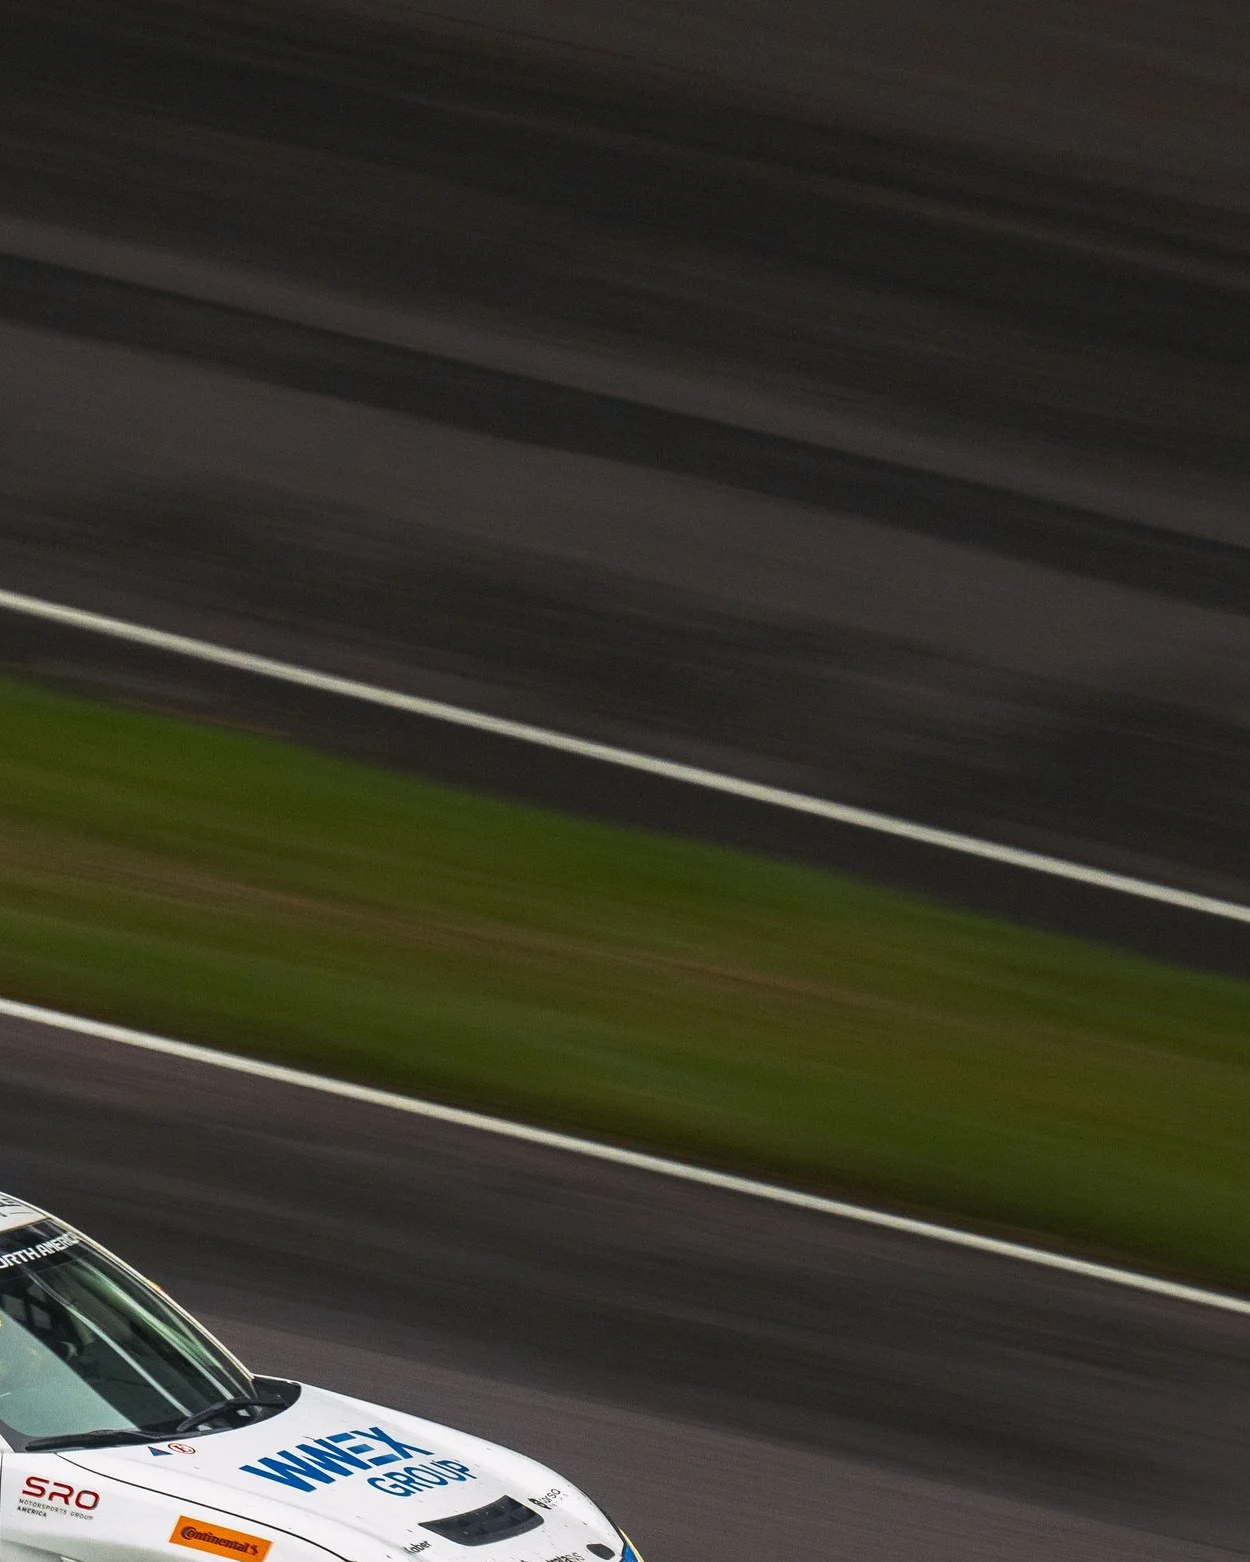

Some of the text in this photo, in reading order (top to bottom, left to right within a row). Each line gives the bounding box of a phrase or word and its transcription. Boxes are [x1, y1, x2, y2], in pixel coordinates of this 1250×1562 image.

[239, 1426, 435, 1493] WWEX
[22, 1476, 101, 1510] SRO
[367, 1460, 478, 1497] GROUP
[17, 1506, 47, 1518] AMERICA
[19, 1498, 93, 1521] MOTORSPORTS GROUP
[181, 1526, 249, 1554] Continental
